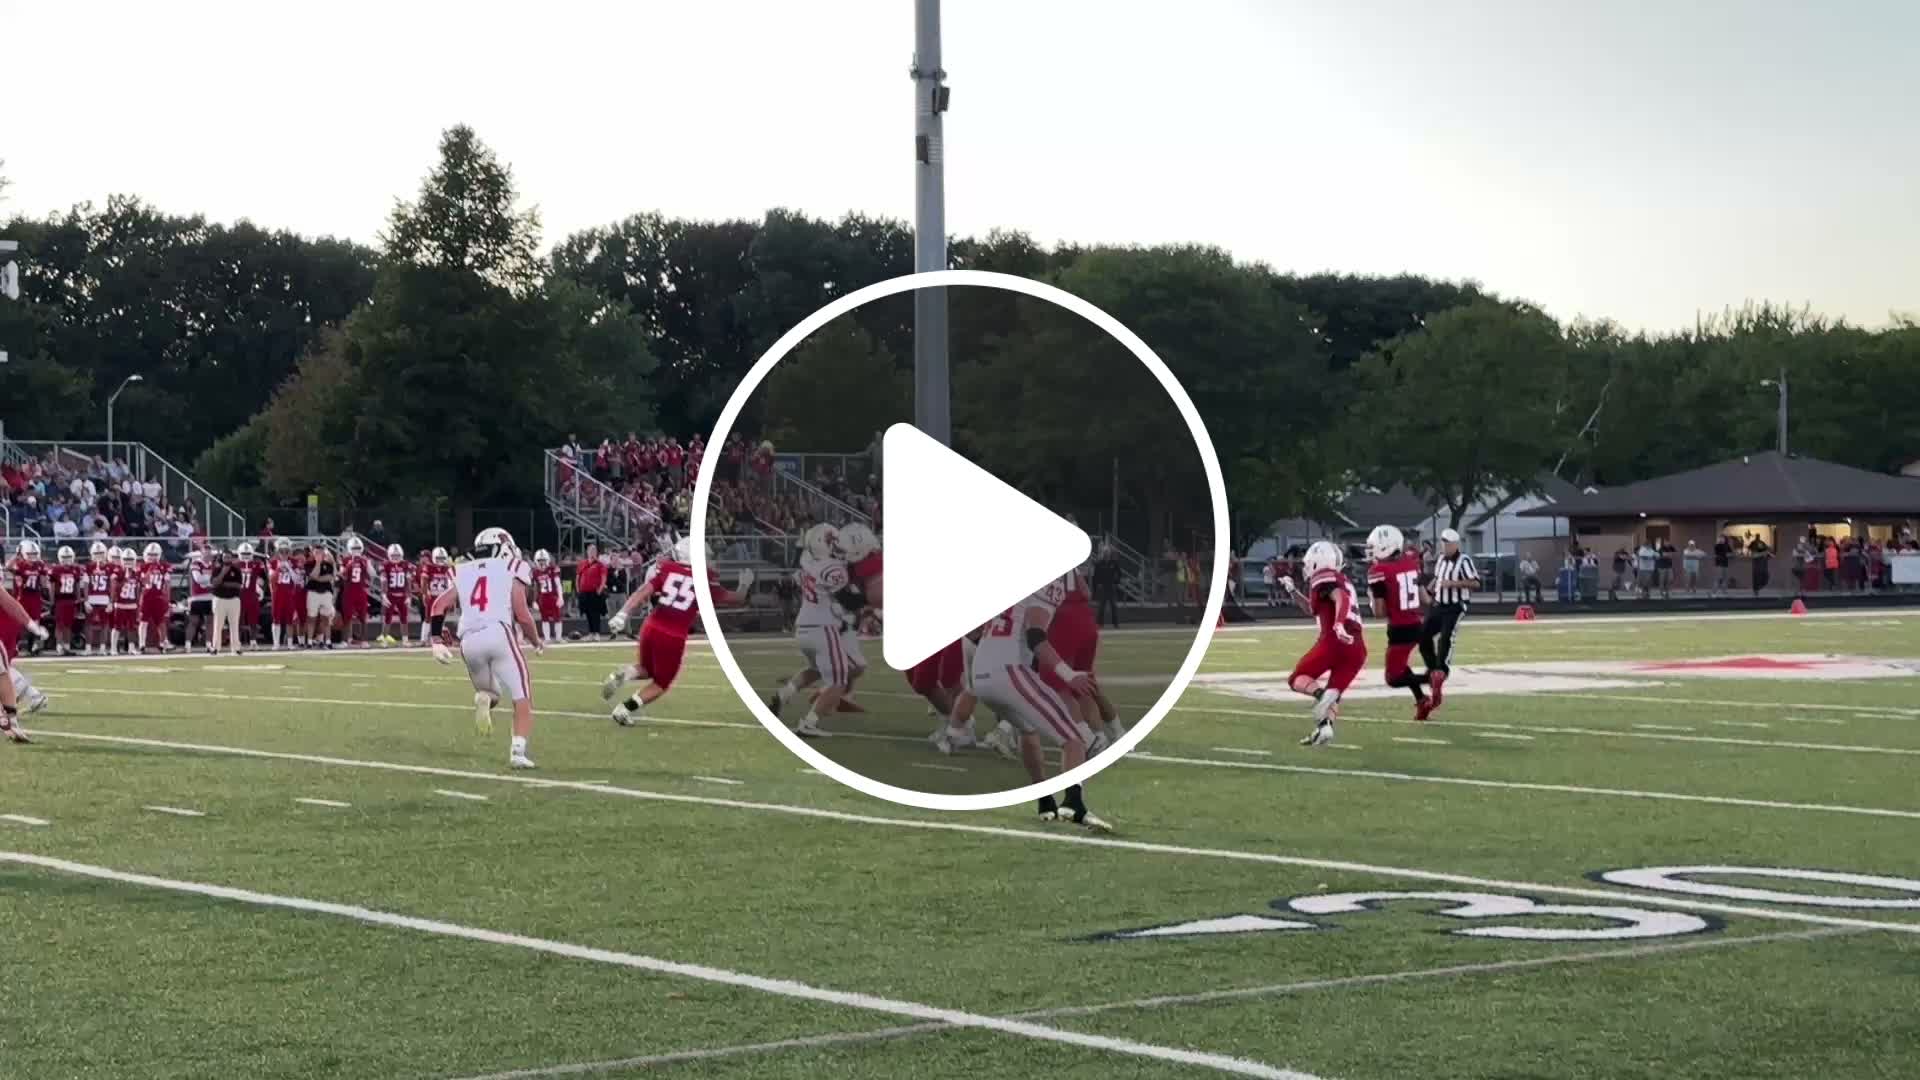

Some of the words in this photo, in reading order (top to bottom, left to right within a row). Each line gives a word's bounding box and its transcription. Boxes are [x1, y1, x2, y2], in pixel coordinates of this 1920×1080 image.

[60, 573, 75, 594] 18
[389, 572, 405, 588] 30
[470, 575, 489, 612] 4
[540, 577, 553, 593] 21
[658, 572, 696, 611] 55
[1396, 570, 1420, 611] 15
